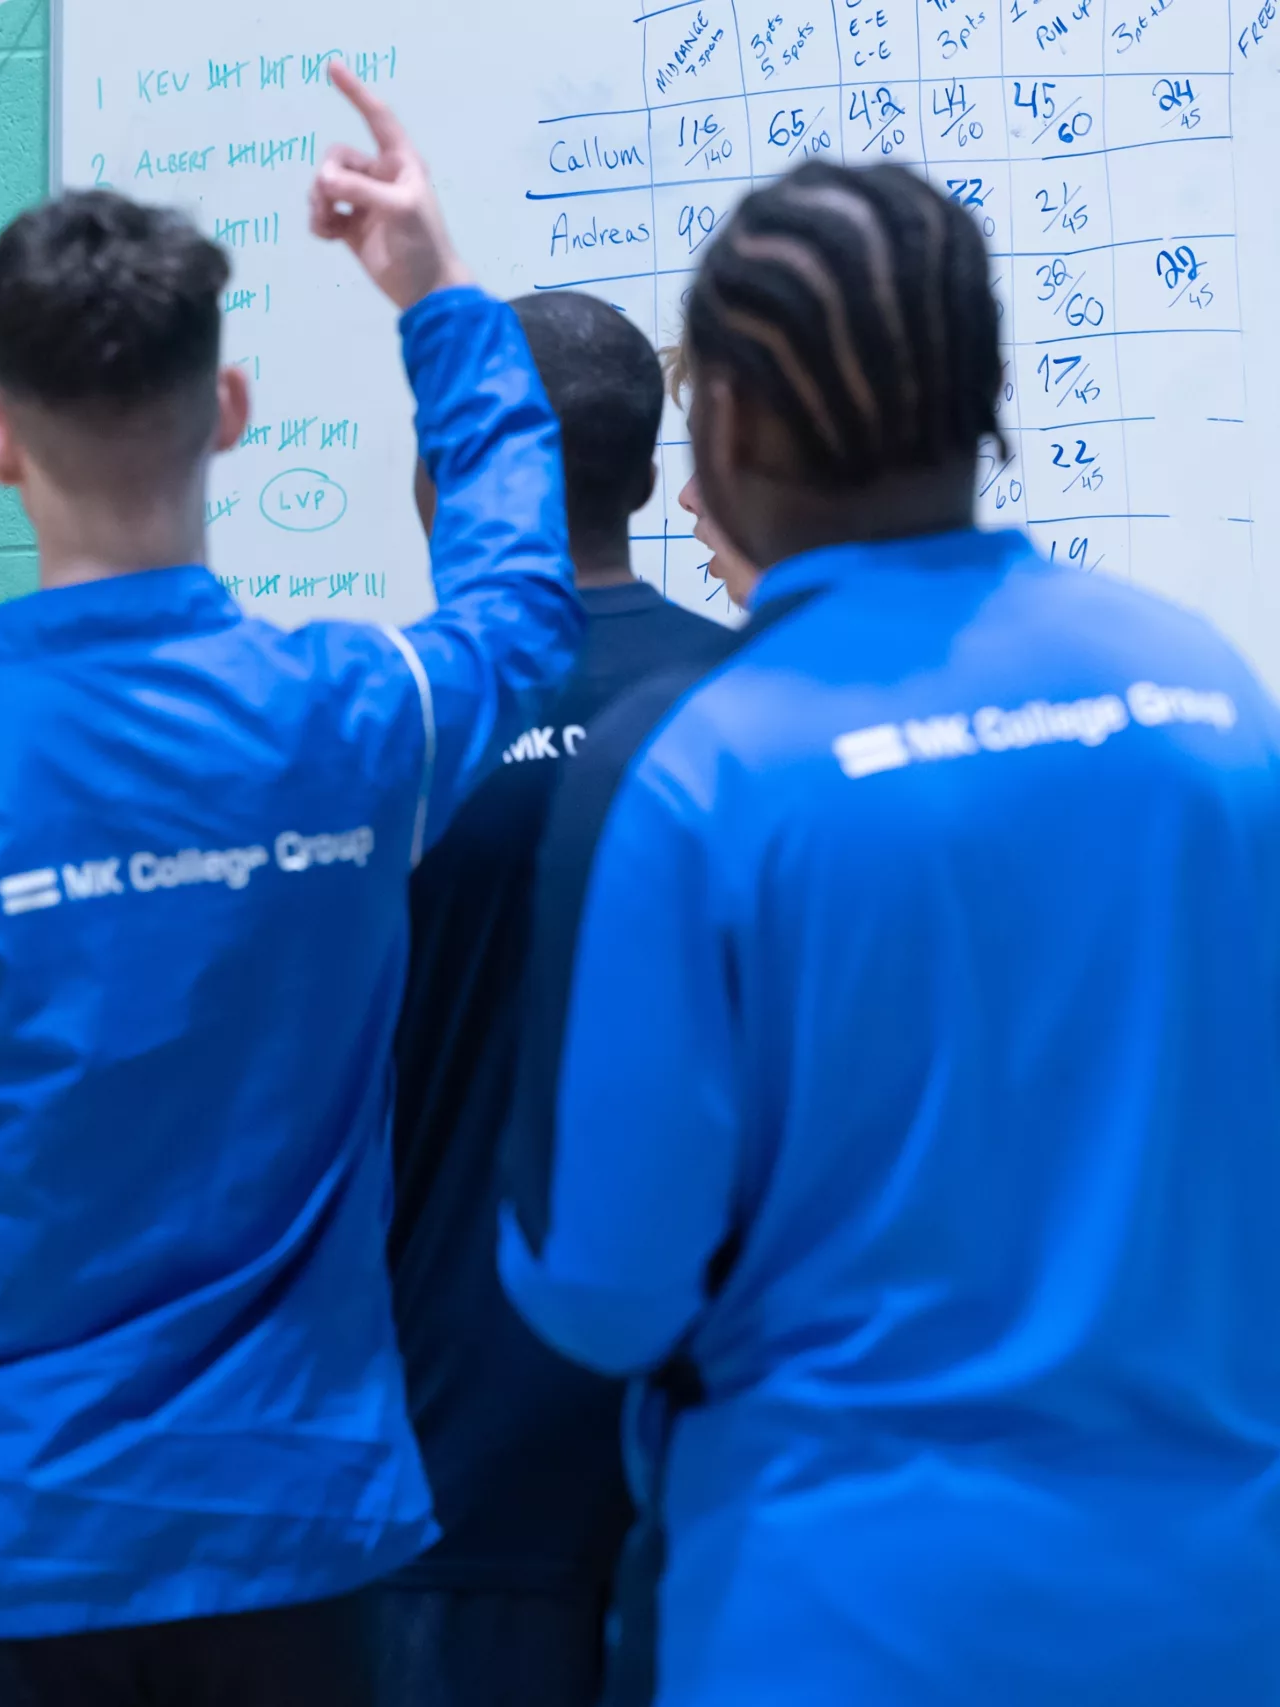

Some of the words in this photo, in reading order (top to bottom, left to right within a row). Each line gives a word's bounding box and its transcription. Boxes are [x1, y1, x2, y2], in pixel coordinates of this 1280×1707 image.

[136, 68, 191, 104] KEV
[134, 145, 217, 179] ALBERT
[548, 135, 646, 174] Callum
[550, 211, 652, 257] Andreas
[278, 489, 326, 511] LVP
[61, 854, 125, 901] MK
[128, 844, 270, 893] College
[274, 824, 375, 873] Group
